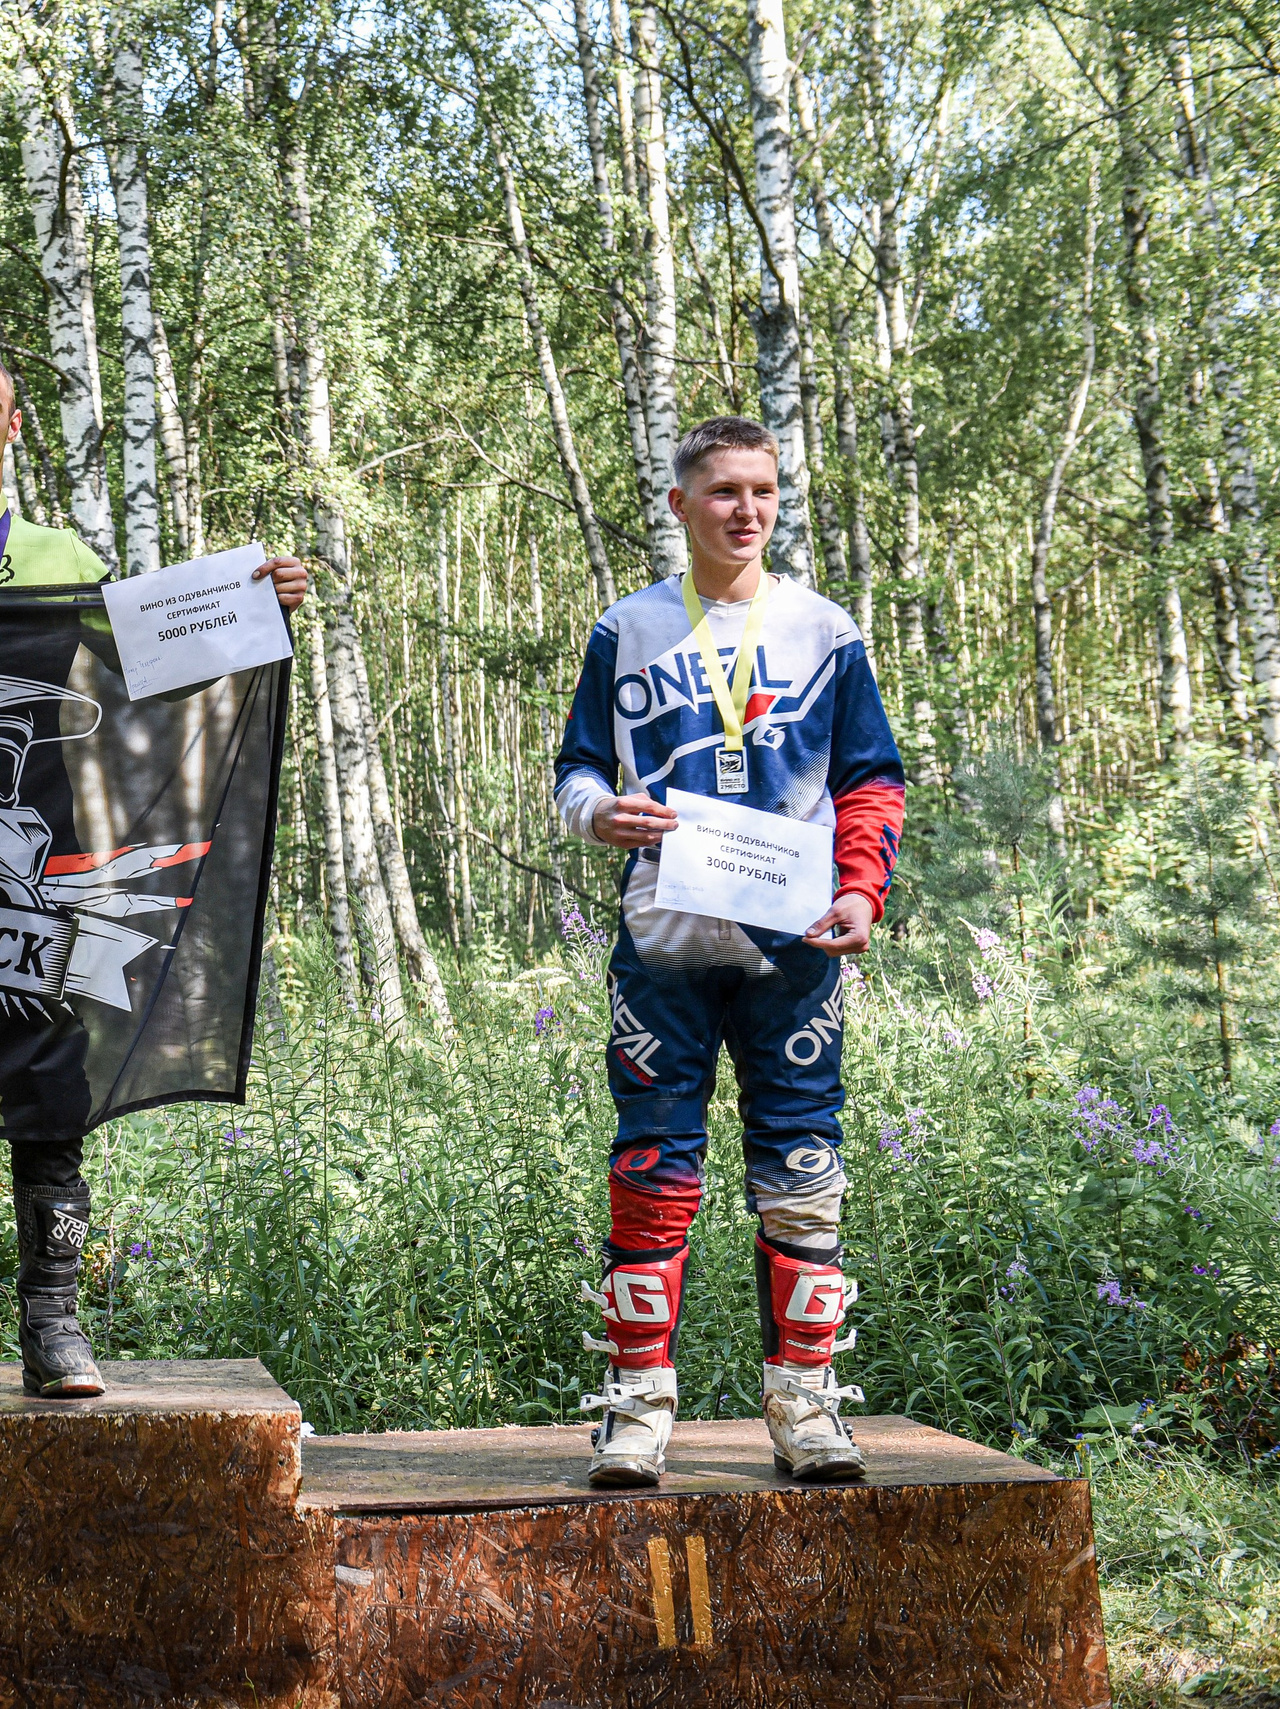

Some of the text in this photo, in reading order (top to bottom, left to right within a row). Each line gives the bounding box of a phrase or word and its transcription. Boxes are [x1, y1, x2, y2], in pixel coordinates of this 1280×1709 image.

[139, 581, 241, 613] ВИНО ИЗ ОДУВАНЧИКОВ
[166, 600, 221, 621] СЕРТИФИКАТ
[158, 611, 238, 642] 5000 РУБЛЕЙ
[696, 824, 801, 858] ВИНО ИЗ ОДУВАНЧИКОВ
[719, 844, 777, 865] СЕРТИФИКАТ
[706, 856, 787, 887] 3000 РУБЛЕЙ
[613, 1271, 670, 1323] G
[785, 1274, 843, 1323] G
